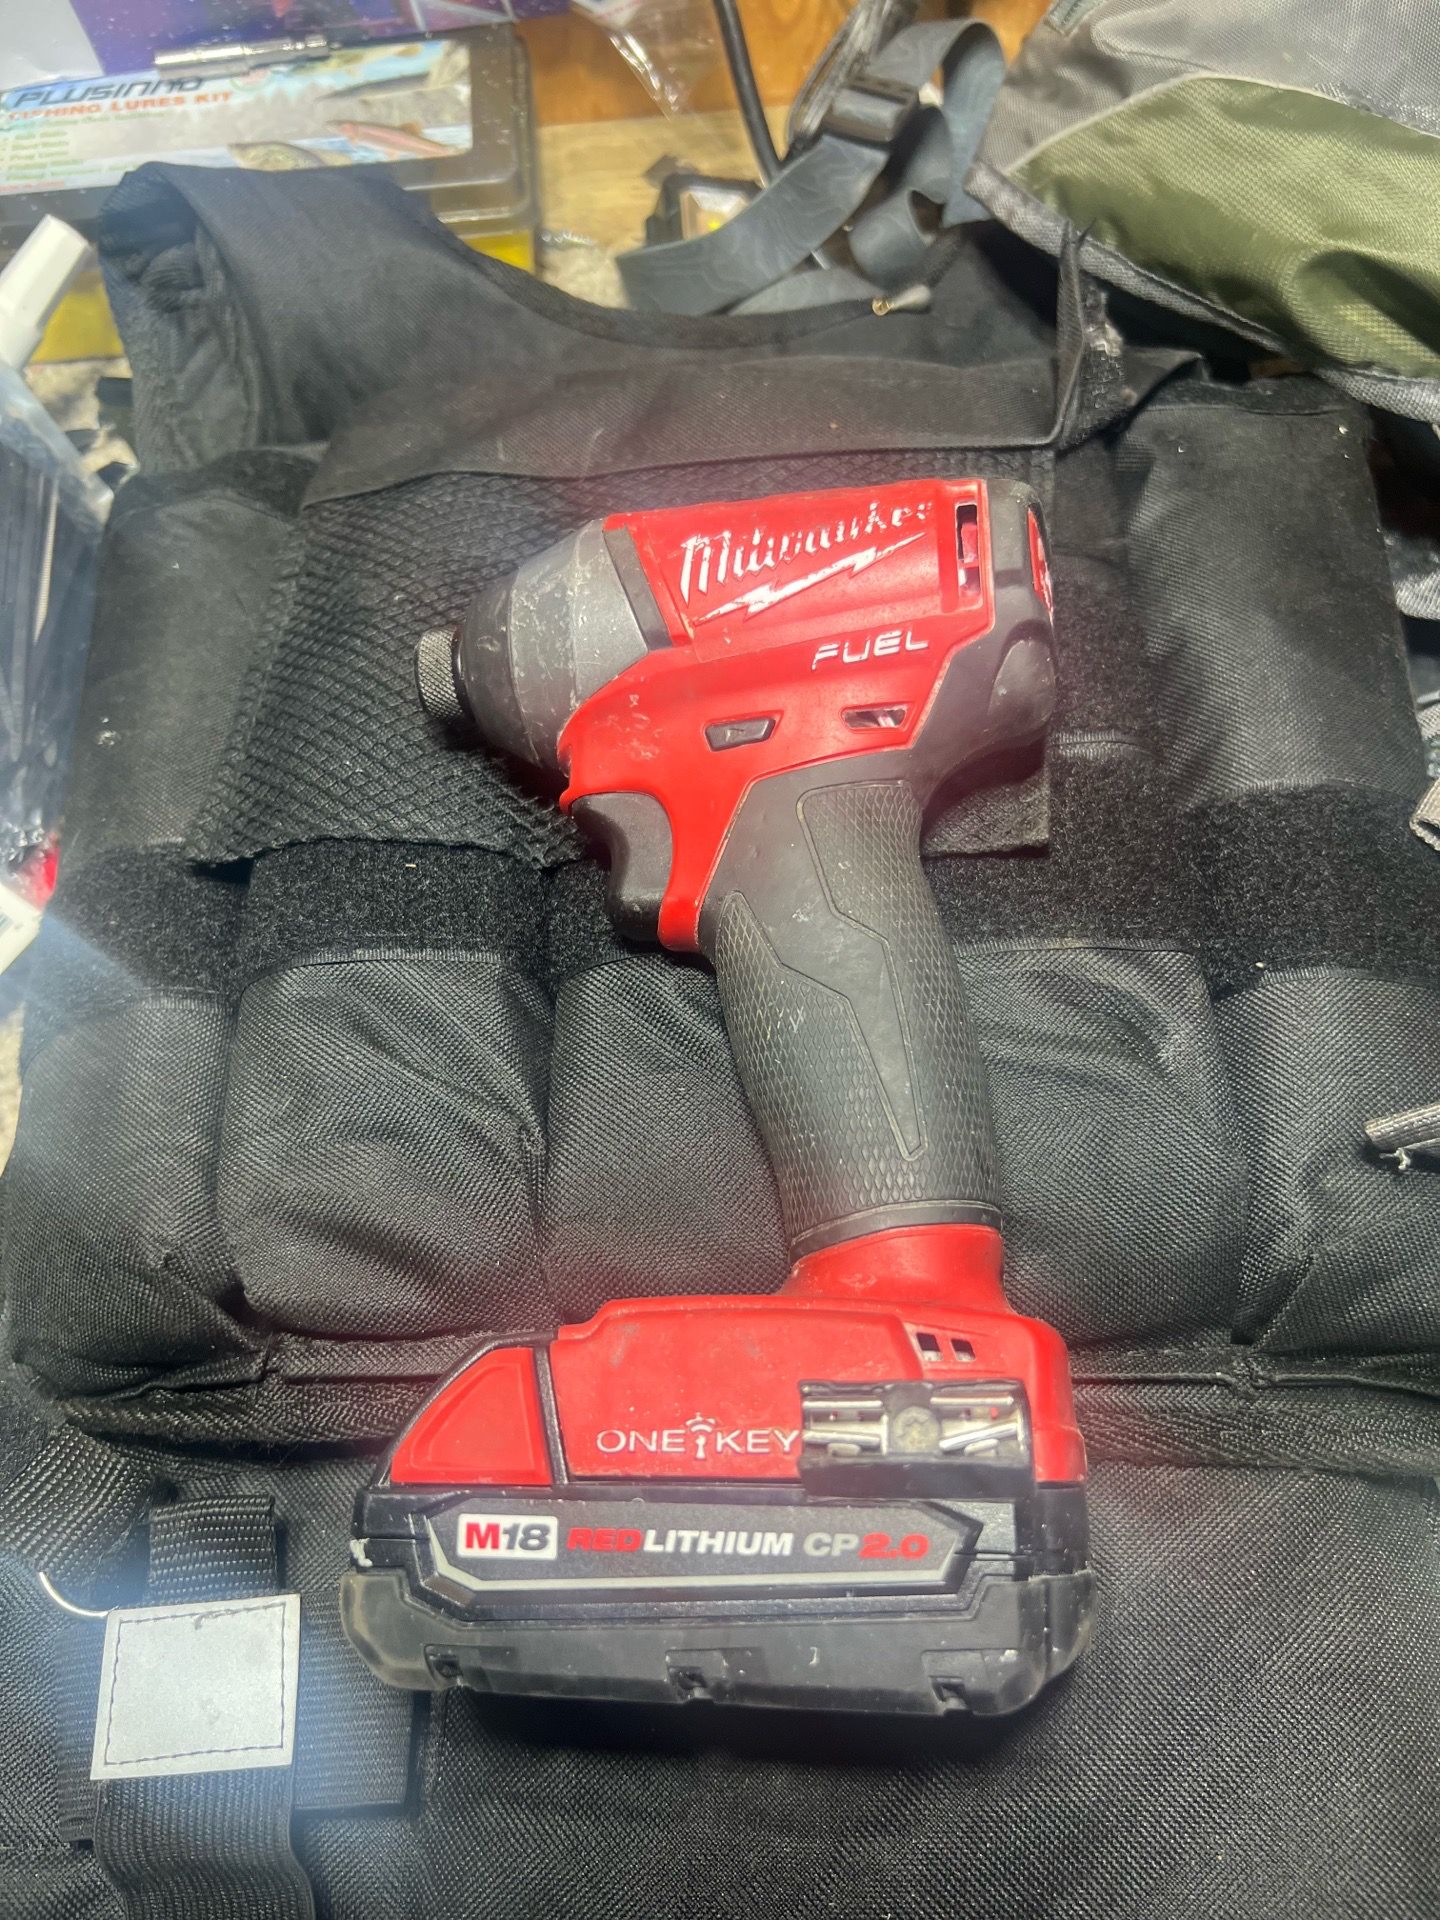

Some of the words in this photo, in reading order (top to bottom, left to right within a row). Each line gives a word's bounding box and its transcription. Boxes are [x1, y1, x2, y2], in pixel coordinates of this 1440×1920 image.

[111, 96, 185, 112] LURES
[194, 91, 233, 105] KIT
[811, 628, 929, 671] FUEL
[464, 1522, 550, 1552] M18
[802, 1532, 931, 1561] CP2.0
